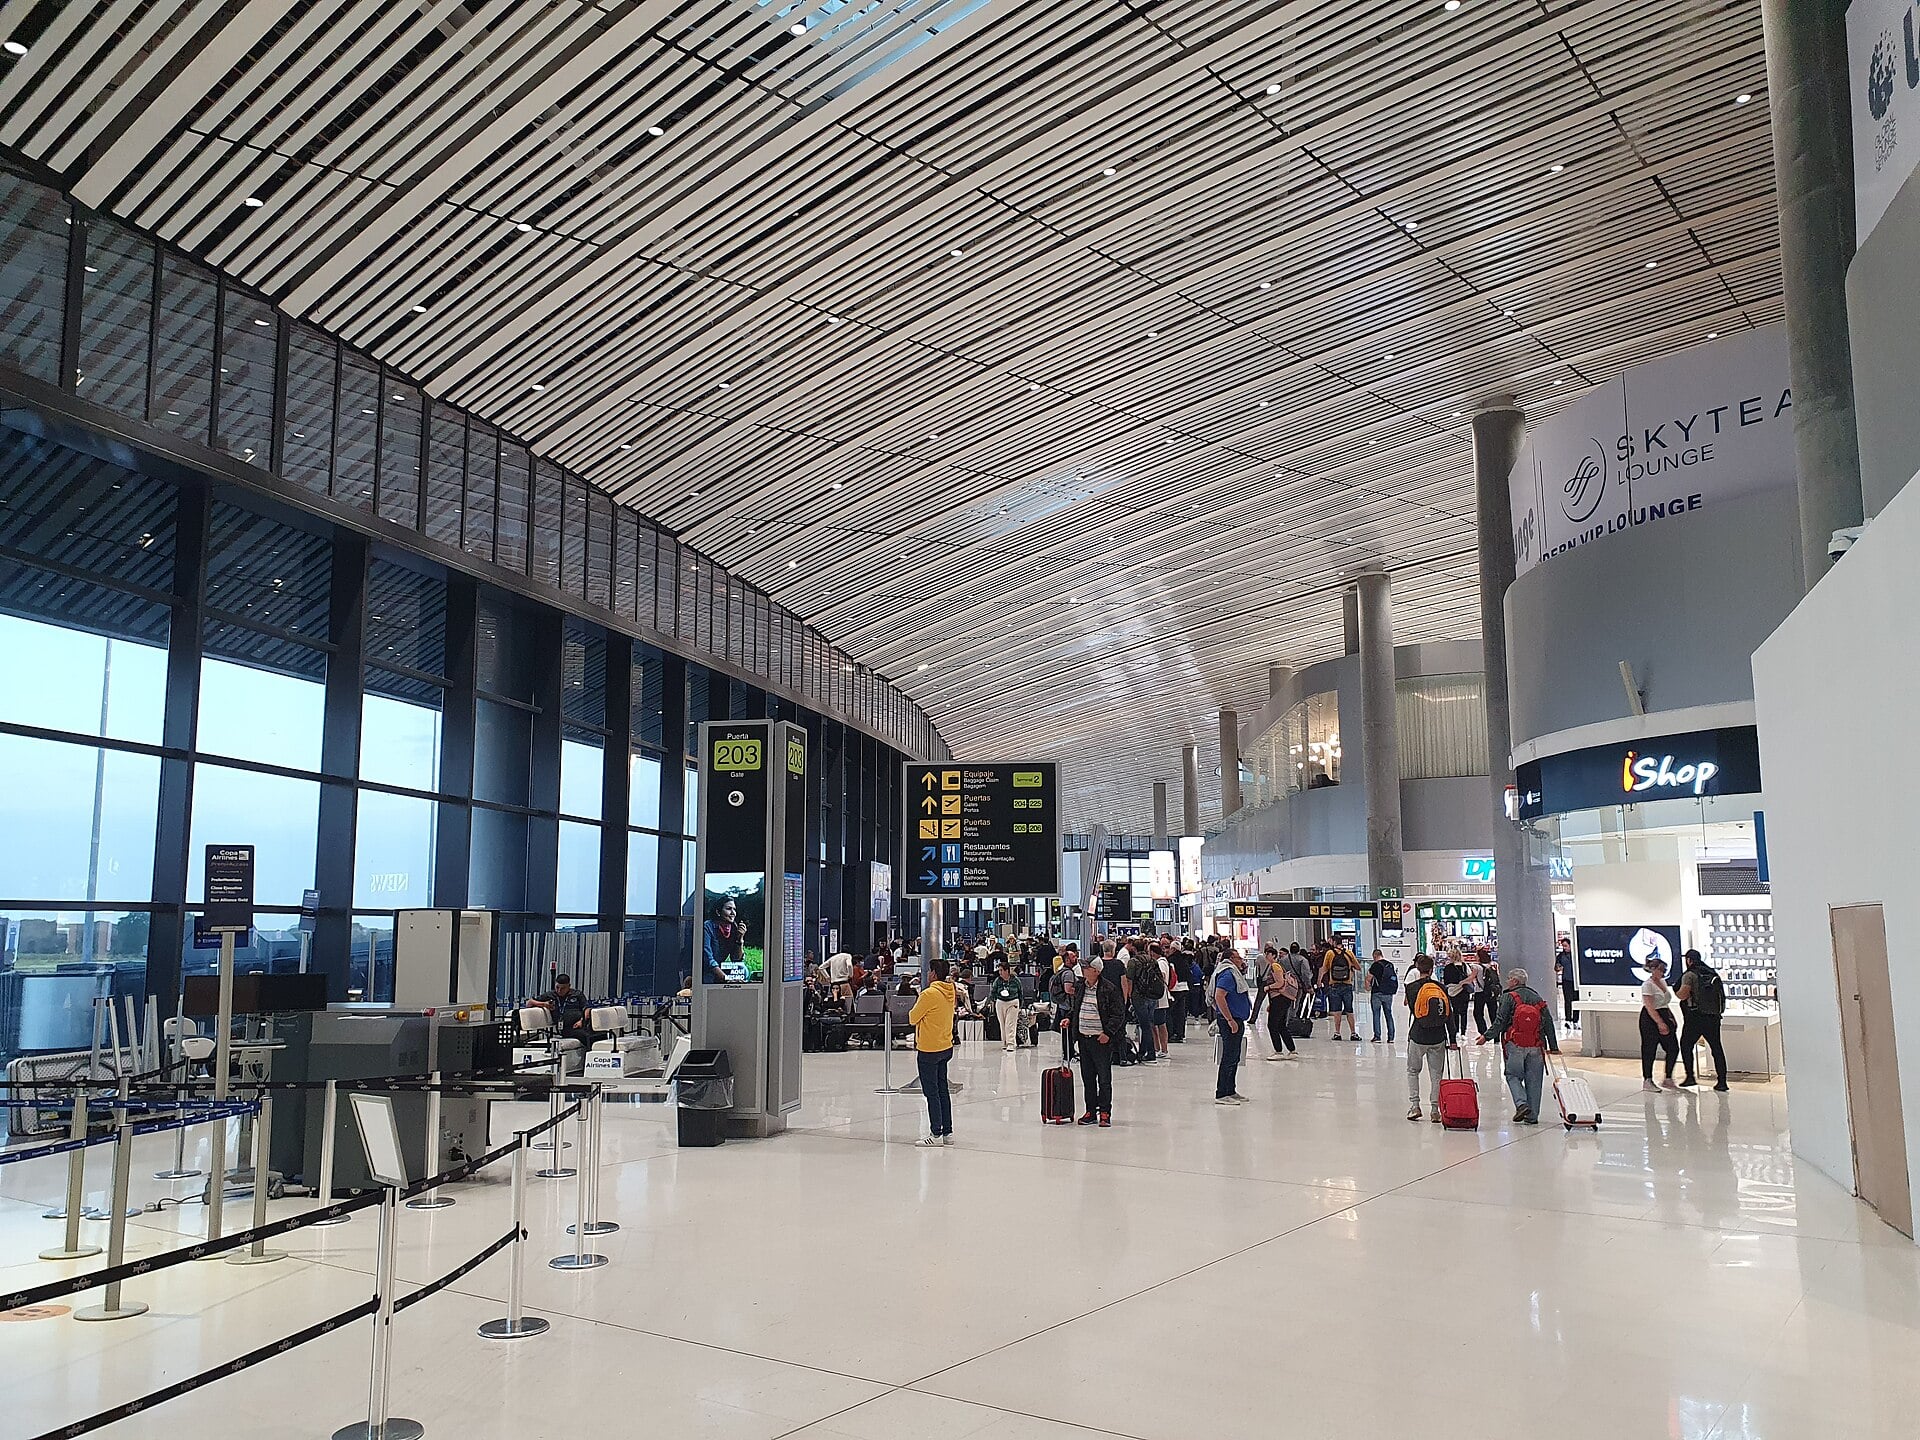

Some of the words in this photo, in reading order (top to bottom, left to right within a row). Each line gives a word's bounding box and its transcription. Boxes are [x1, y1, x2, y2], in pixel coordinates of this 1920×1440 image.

[1617, 443, 1715, 486] LOUNGE
[1579, 524, 1604, 546] VIP
[1607, 494, 1703, 534] LOUNGE
[717, 745, 758, 765] 203
[789, 747, 803, 769] 203
[1034, 776, 1040, 784] 2
[1623, 750, 1720, 795] iShop
[1440, 906, 1458, 918] LA
[1592, 950, 1622, 958] WATCH
